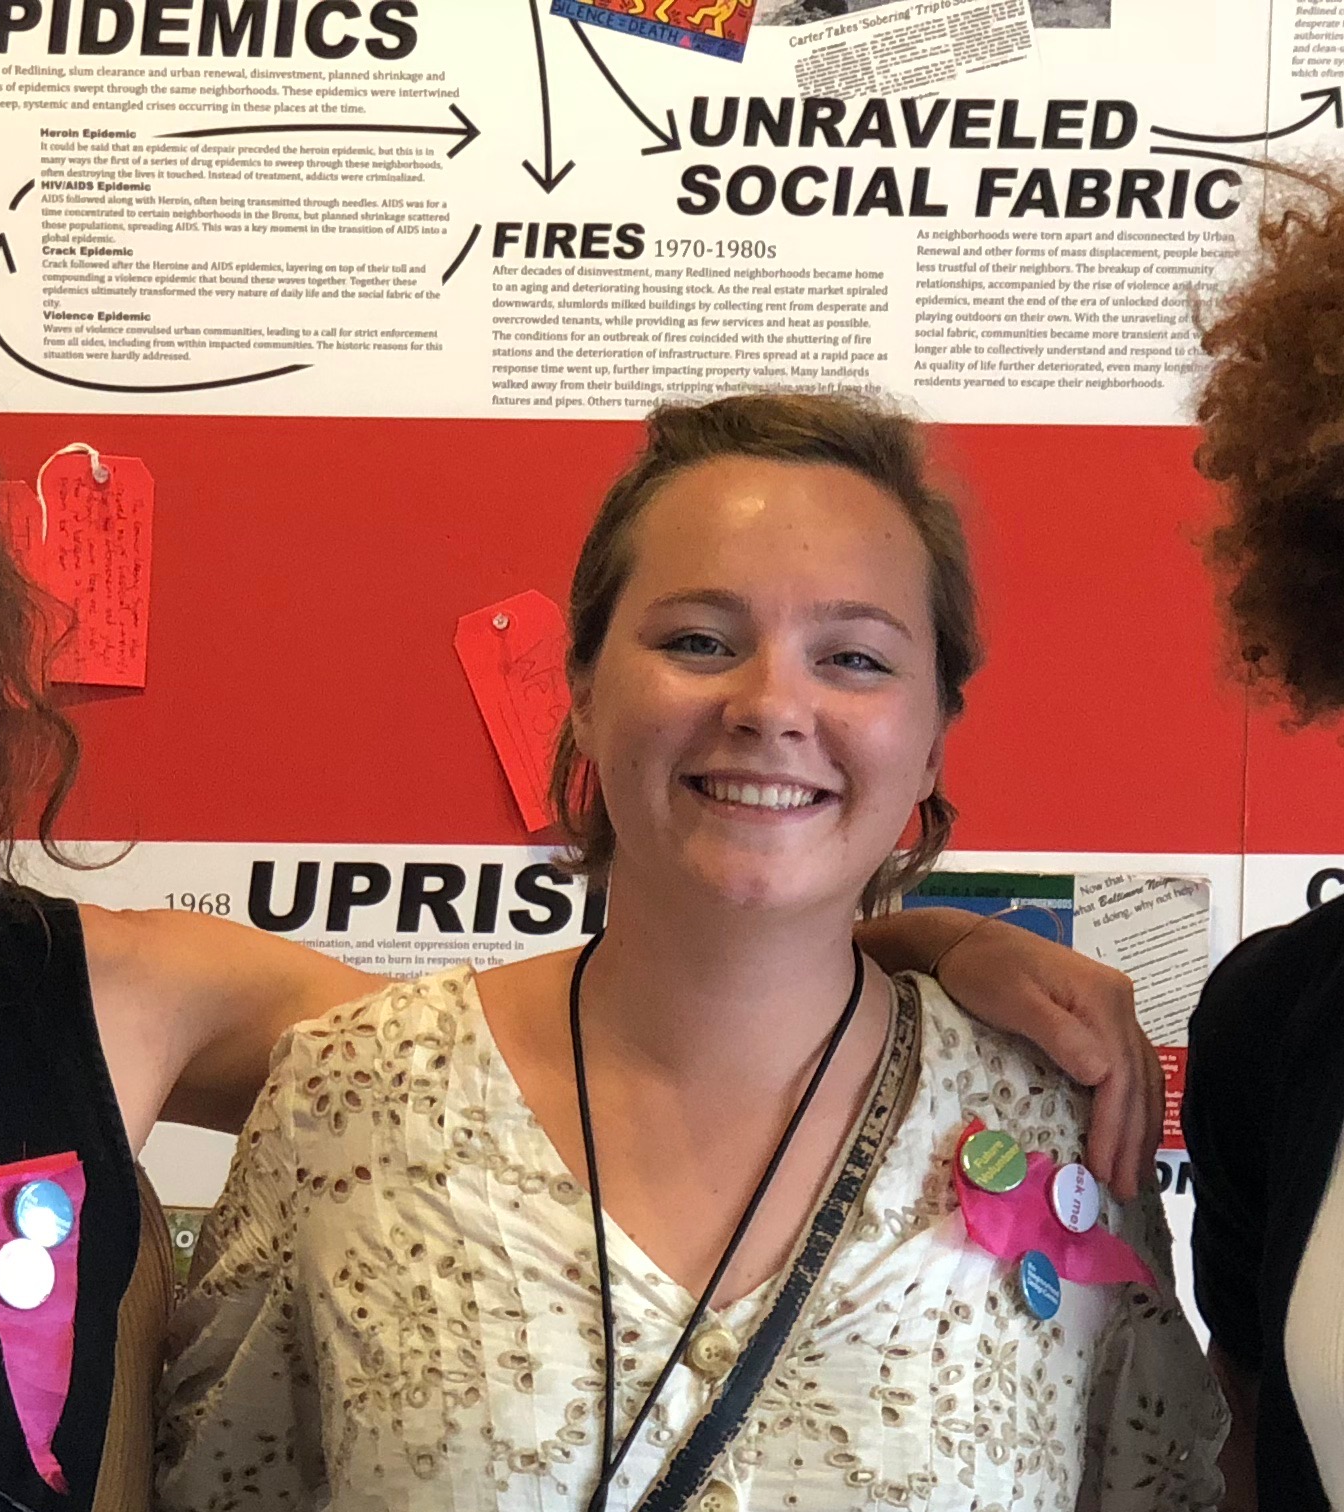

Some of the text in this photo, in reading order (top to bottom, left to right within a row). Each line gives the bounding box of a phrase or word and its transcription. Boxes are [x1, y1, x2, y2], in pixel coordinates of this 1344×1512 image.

[789, 30, 824, 48] Carter
[825, 23, 858, 40] Takes
[2, 64, 12, 75] of
[15, 64, 66, 79] Redlining,
[69, 65, 94, 76] slum
[97, 65, 145, 77] clearance
[148, 67, 167, 78] and
[170, 67, 200, 78] urban
[204, 68, 247, 79] renewal,
[250, 67, 325, 81] disinvestment,
[329, 69, 369, 82] planned
[373, 70, 423, 83] shrinkage
[426, 70, 445, 81] and
[690, 91, 1137, 150] UNRAVELED
[40, 127, 136, 140] Heroin Epidemic
[41, 180, 151, 192] HIV/AIDS Epidemic
[677, 163, 1248, 220] SOCIAL FABRIC
[493, 222, 776, 259] FIRES 1970-1980s
[42, 245, 133, 258] Crack Epidemic
[493, 264, 884, 281] After decades of disinvestment, many Redlined neighborhoods became home
[43, 310, 150, 323] Violence Epidemic
[1080, 882, 1103, 896] Now
[1156, 892, 1171, 904] not
[164, 892, 232, 917] 1968
[1076, 1164, 1087, 1198] ask
